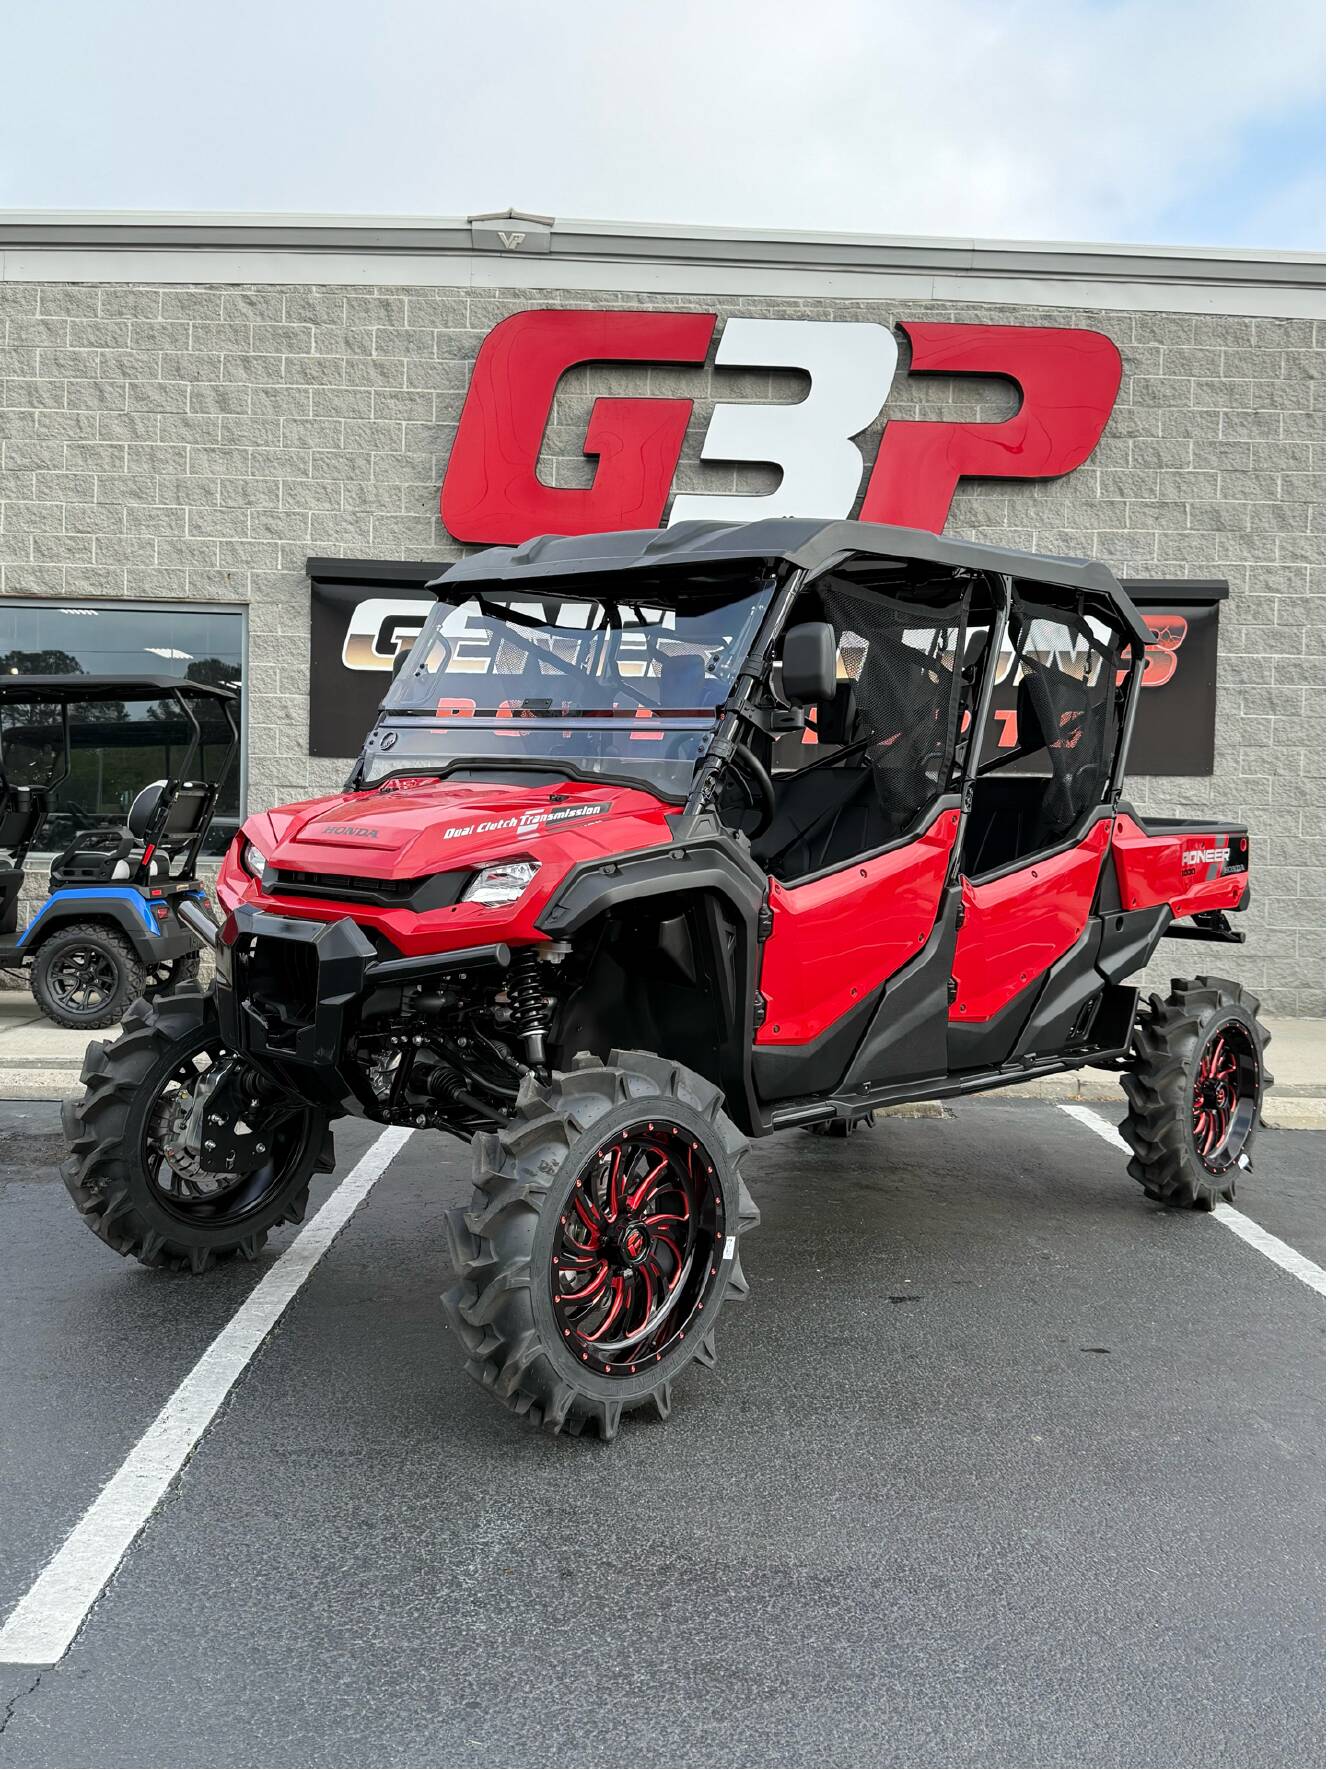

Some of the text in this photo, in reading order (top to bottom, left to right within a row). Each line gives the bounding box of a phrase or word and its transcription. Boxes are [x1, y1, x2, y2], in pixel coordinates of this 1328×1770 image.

[322, 825, 378, 838] HONDA
[443, 824, 474, 840] Dual
[476, 816, 518, 833] Clutch
[518, 806, 601, 826] Transmission
